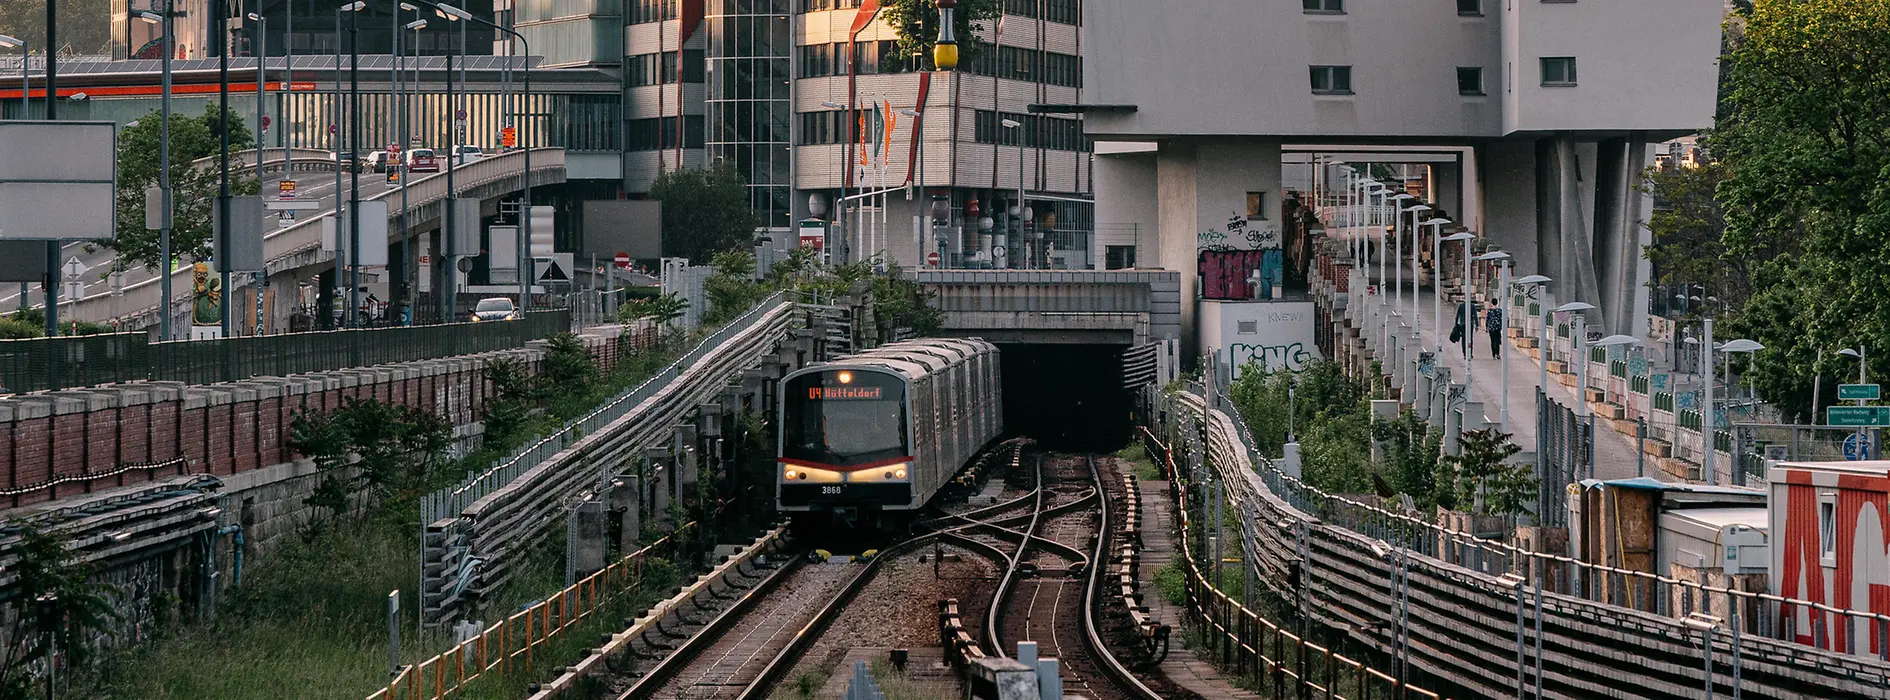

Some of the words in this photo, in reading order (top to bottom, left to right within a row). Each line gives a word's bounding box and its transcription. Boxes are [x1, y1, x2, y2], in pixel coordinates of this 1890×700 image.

[809, 387, 822, 399] U4
[824, 386, 881, 399] Hütteldorf
[821, 485, 842, 495] 3868
